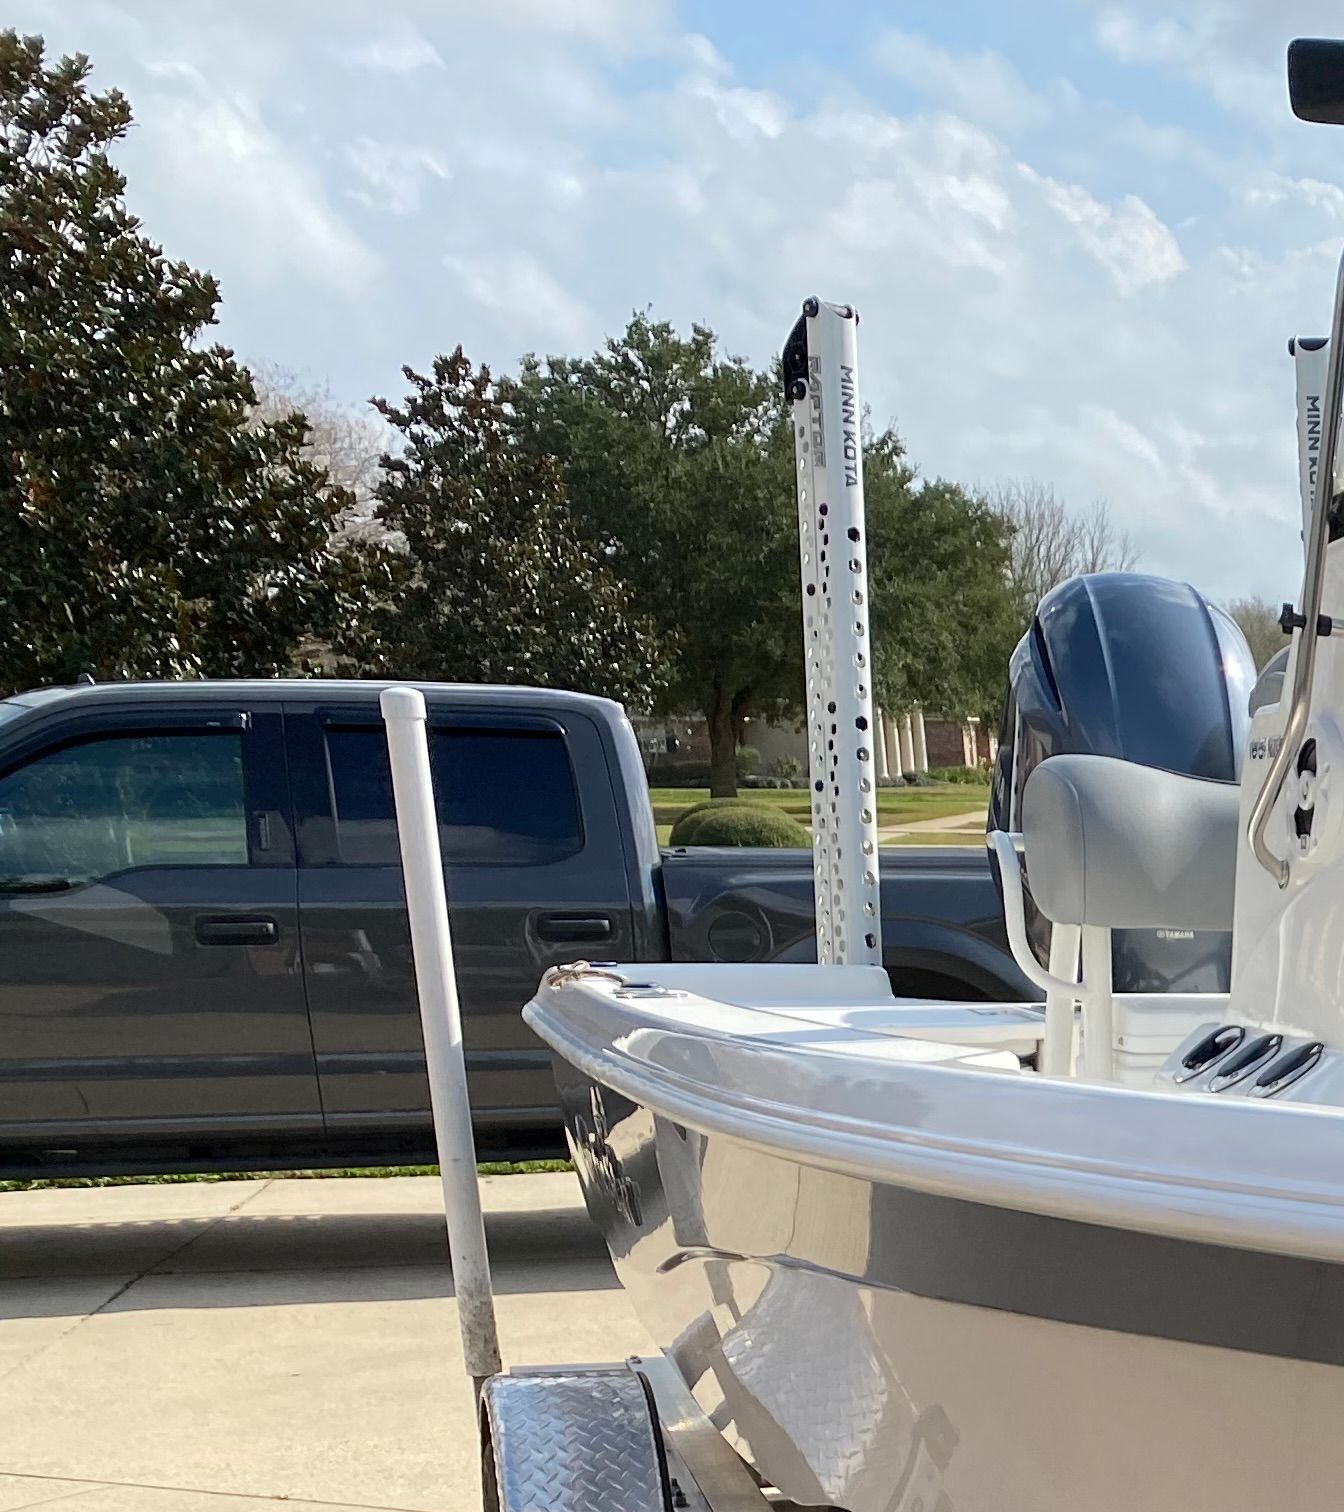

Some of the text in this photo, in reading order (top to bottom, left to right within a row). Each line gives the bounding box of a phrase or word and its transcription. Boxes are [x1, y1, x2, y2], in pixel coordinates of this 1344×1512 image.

[840, 365, 858, 487] MINN KOTA
[1306, 396, 1321, 451] MINN
